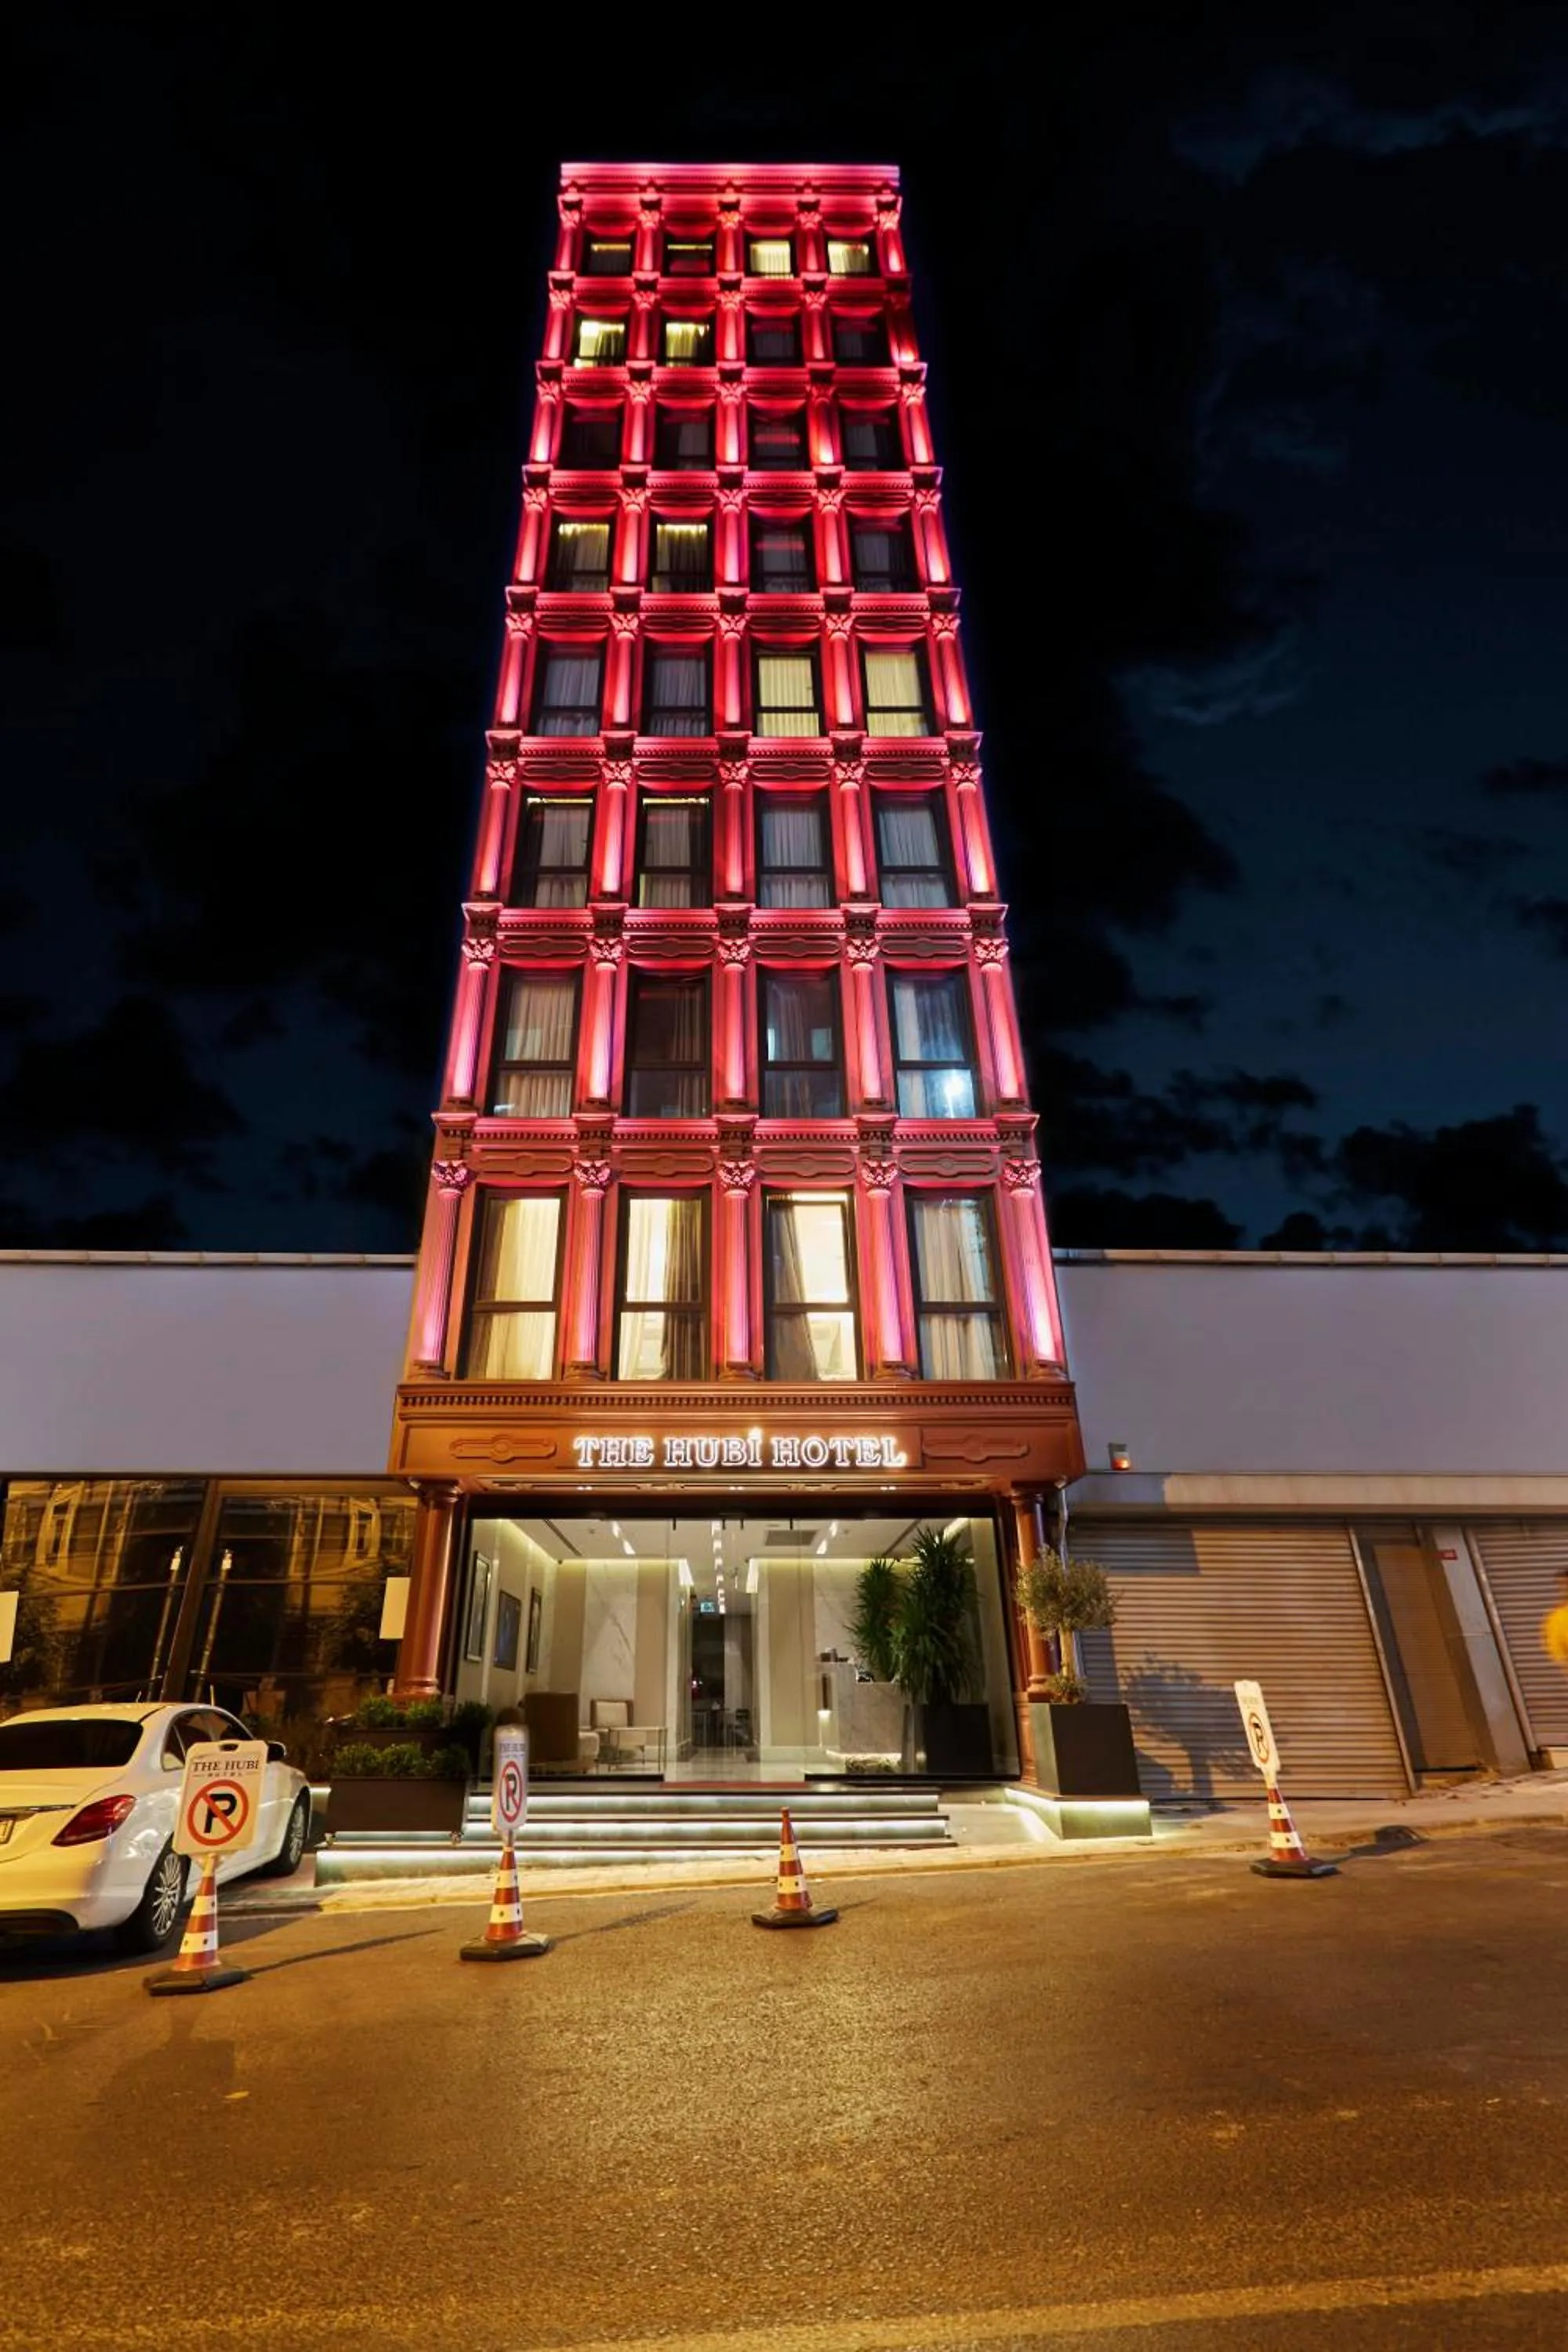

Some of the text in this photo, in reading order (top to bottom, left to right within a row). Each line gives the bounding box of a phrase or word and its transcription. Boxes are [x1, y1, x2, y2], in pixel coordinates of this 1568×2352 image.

[574, 1436, 654, 1467] THE
[771, 1436, 906, 1468] HOTEL
[193, 1761, 220, 1772] THE
